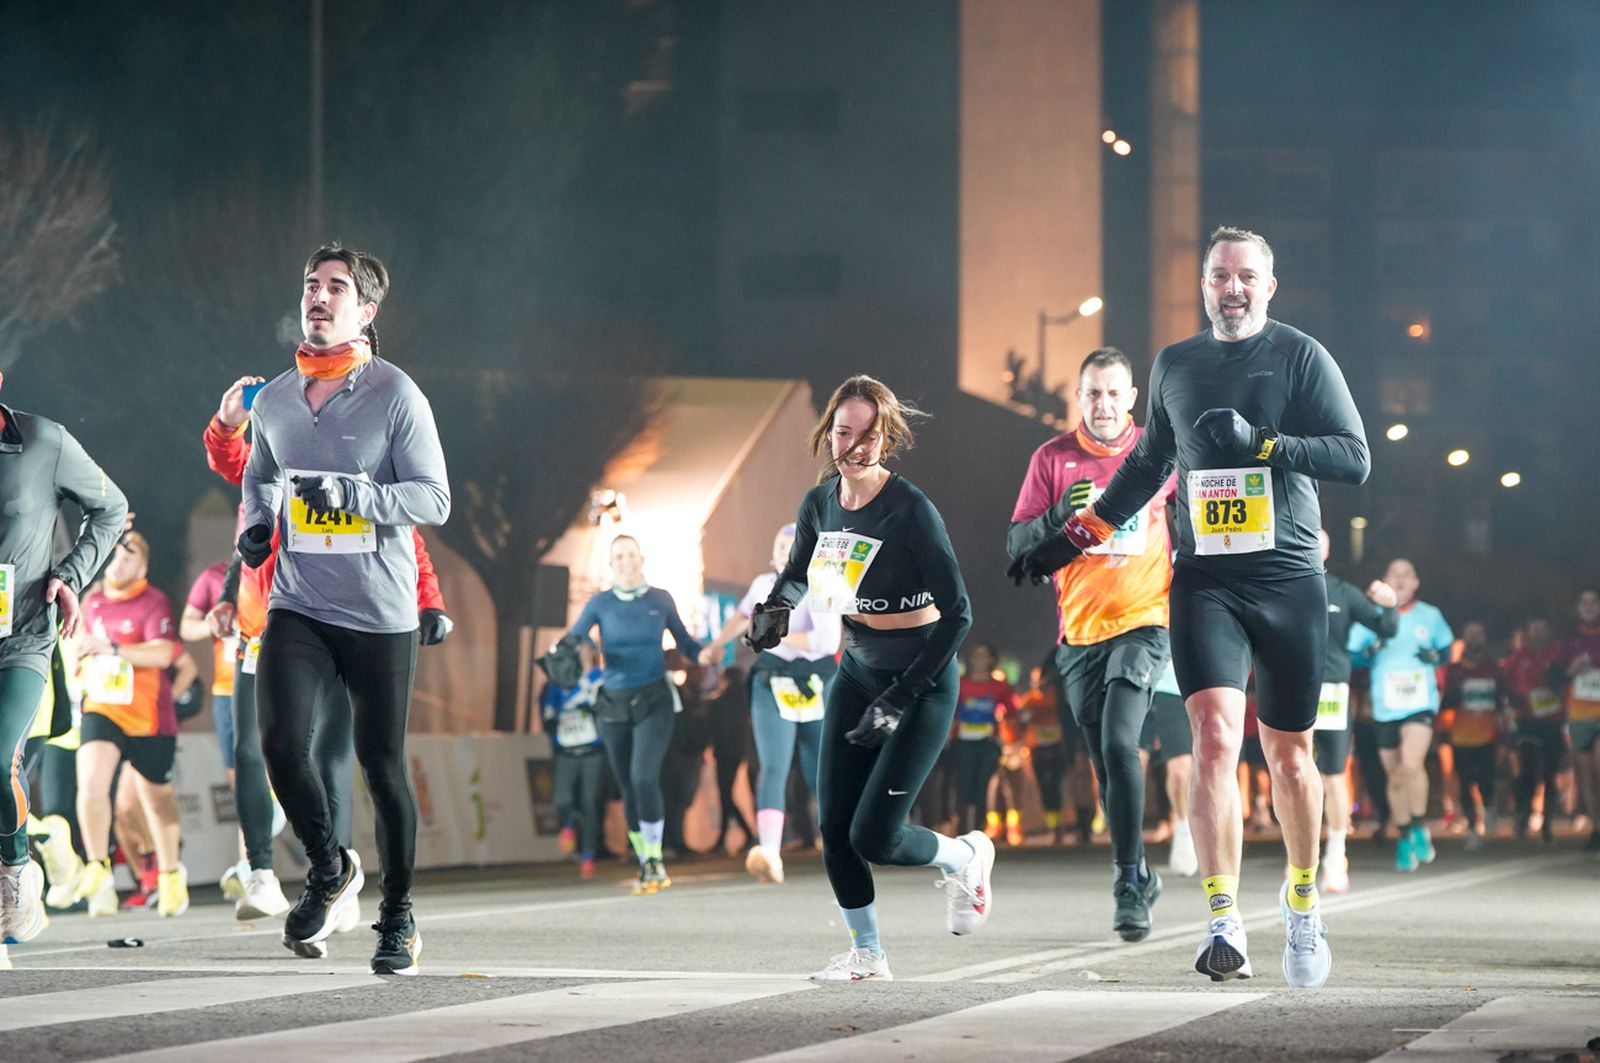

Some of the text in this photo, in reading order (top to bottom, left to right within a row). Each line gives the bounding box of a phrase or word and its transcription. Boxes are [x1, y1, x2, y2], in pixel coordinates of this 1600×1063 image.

[1201, 478, 1237, 488] NOCHE DE
[1208, 486, 1238, 498] ANTÓN
[1206, 499, 1247, 525] 873
